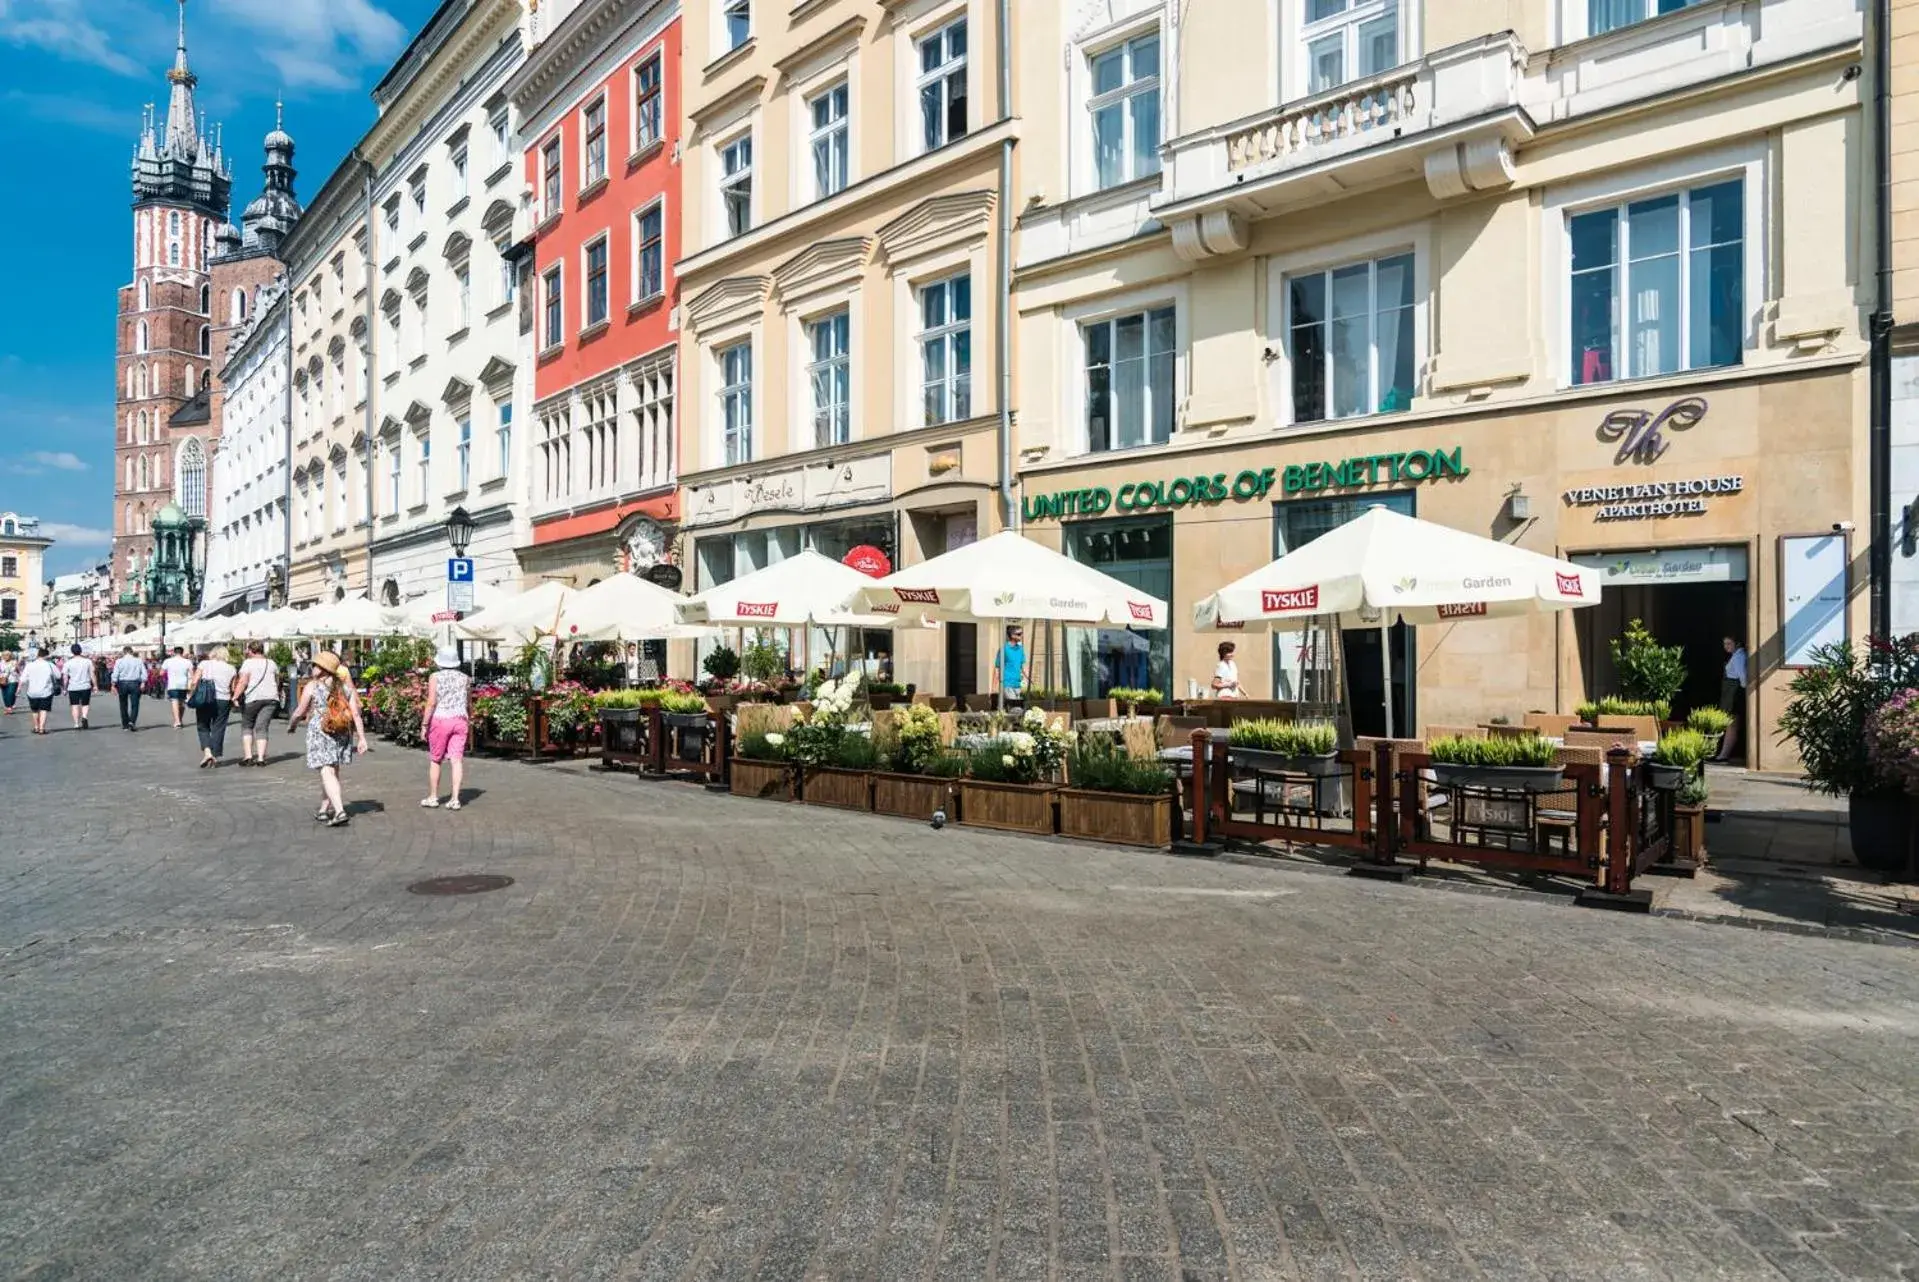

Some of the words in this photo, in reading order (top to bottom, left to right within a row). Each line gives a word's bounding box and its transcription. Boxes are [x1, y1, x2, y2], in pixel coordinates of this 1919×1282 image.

[1022, 486, 1112, 520] UNITED
[1117, 472, 1228, 509] COLORS
[1233, 467, 1275, 499] OF
[1567, 482, 1673, 503] VENETIAN
[1674, 475, 1744, 496] HOUSE
[1598, 500, 1708, 518] APARTHOTEL
[453, 561, 468, 580] P
[1463, 576, 1512, 590] Garden
[898, 589, 936, 602] TYSKIE
[1050, 599, 1088, 610] Garden
[1264, 590, 1315, 609] TYSKIE
[740, 602, 776, 616] TYSKIE
